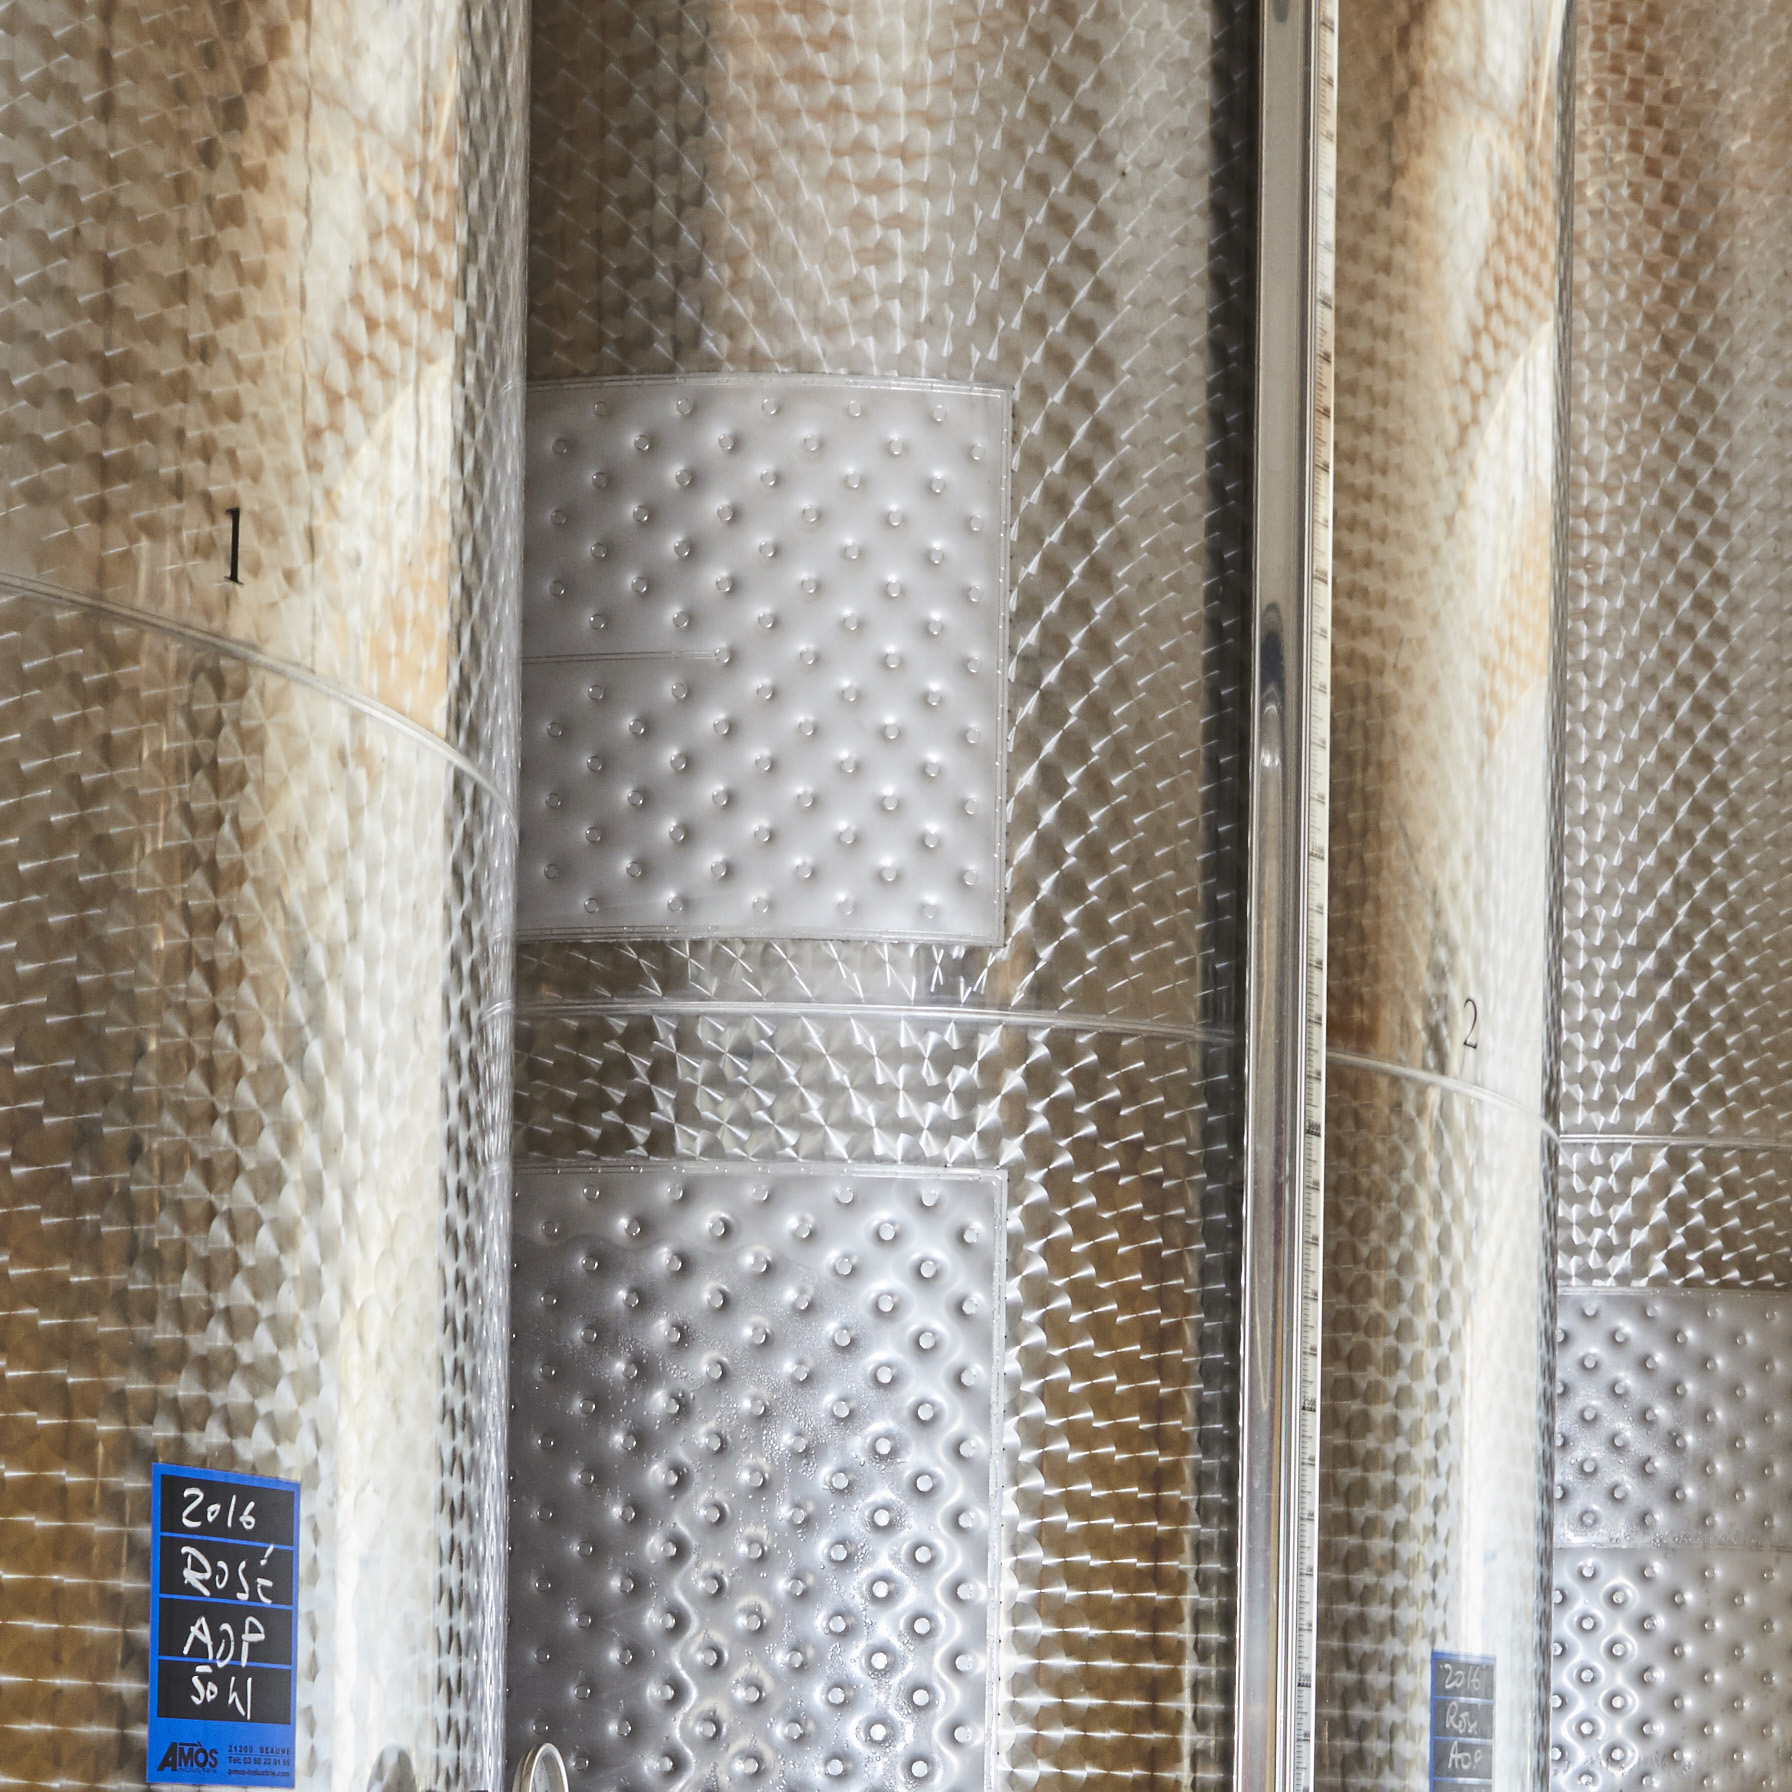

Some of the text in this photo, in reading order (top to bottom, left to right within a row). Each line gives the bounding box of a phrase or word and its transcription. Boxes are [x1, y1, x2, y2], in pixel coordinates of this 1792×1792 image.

[224, 506, 244, 587] 1
[1463, 997, 1478, 1050] 2
[182, 1487, 256, 1531] 2016
[182, 1615, 266, 1669] AOP
[228, 1744, 290, 1755] 21200 BEAUNE
